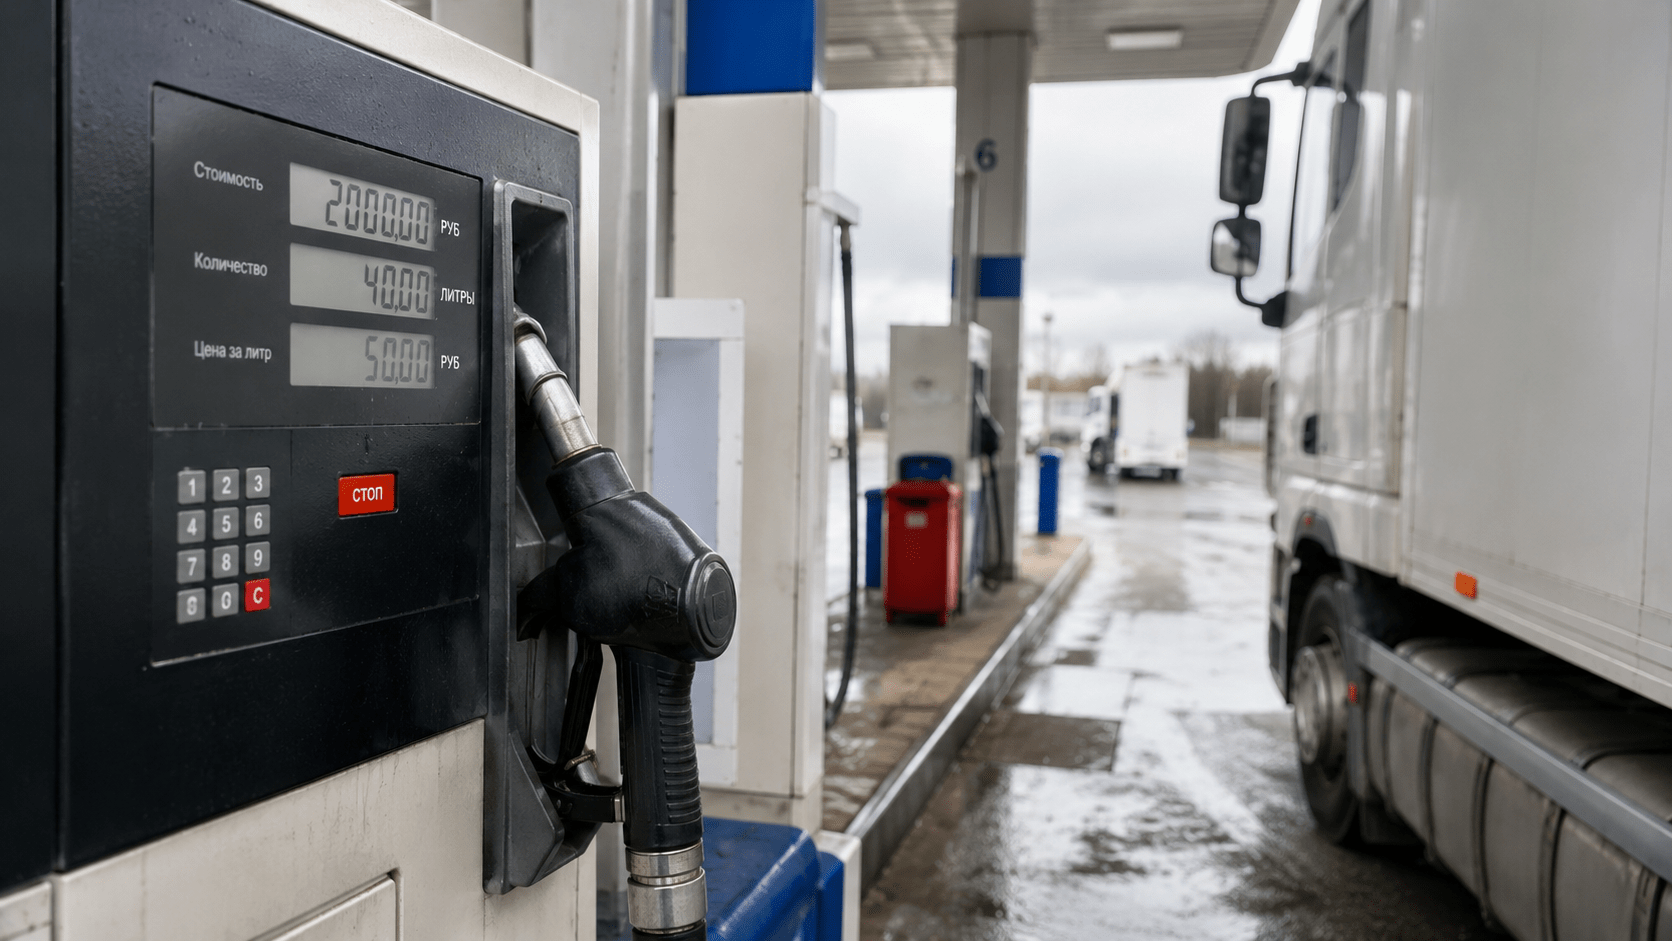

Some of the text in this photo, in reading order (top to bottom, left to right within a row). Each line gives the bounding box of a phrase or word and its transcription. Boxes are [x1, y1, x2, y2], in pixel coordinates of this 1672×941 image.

[974, 138, 998, 173] 6
[193, 160, 264, 191] Стоимость
[325, 178, 430, 245] 2000,00
[440, 219, 460, 237] РУБ
[194, 251, 268, 277] Количество
[364, 263, 430, 314] 40,00
[440, 287, 475, 305] ЛИТРЫ
[194, 340, 273, 364] Цена за литр
[364, 335, 430, 385] 50,00
[440, 354, 460, 370] РУБ
[188, 474, 263, 497] 1 2 3
[352, 486, 383, 503] СТОП
[186, 511, 263, 536] 4 5 6
[187, 548, 263, 576] 7 8 9
